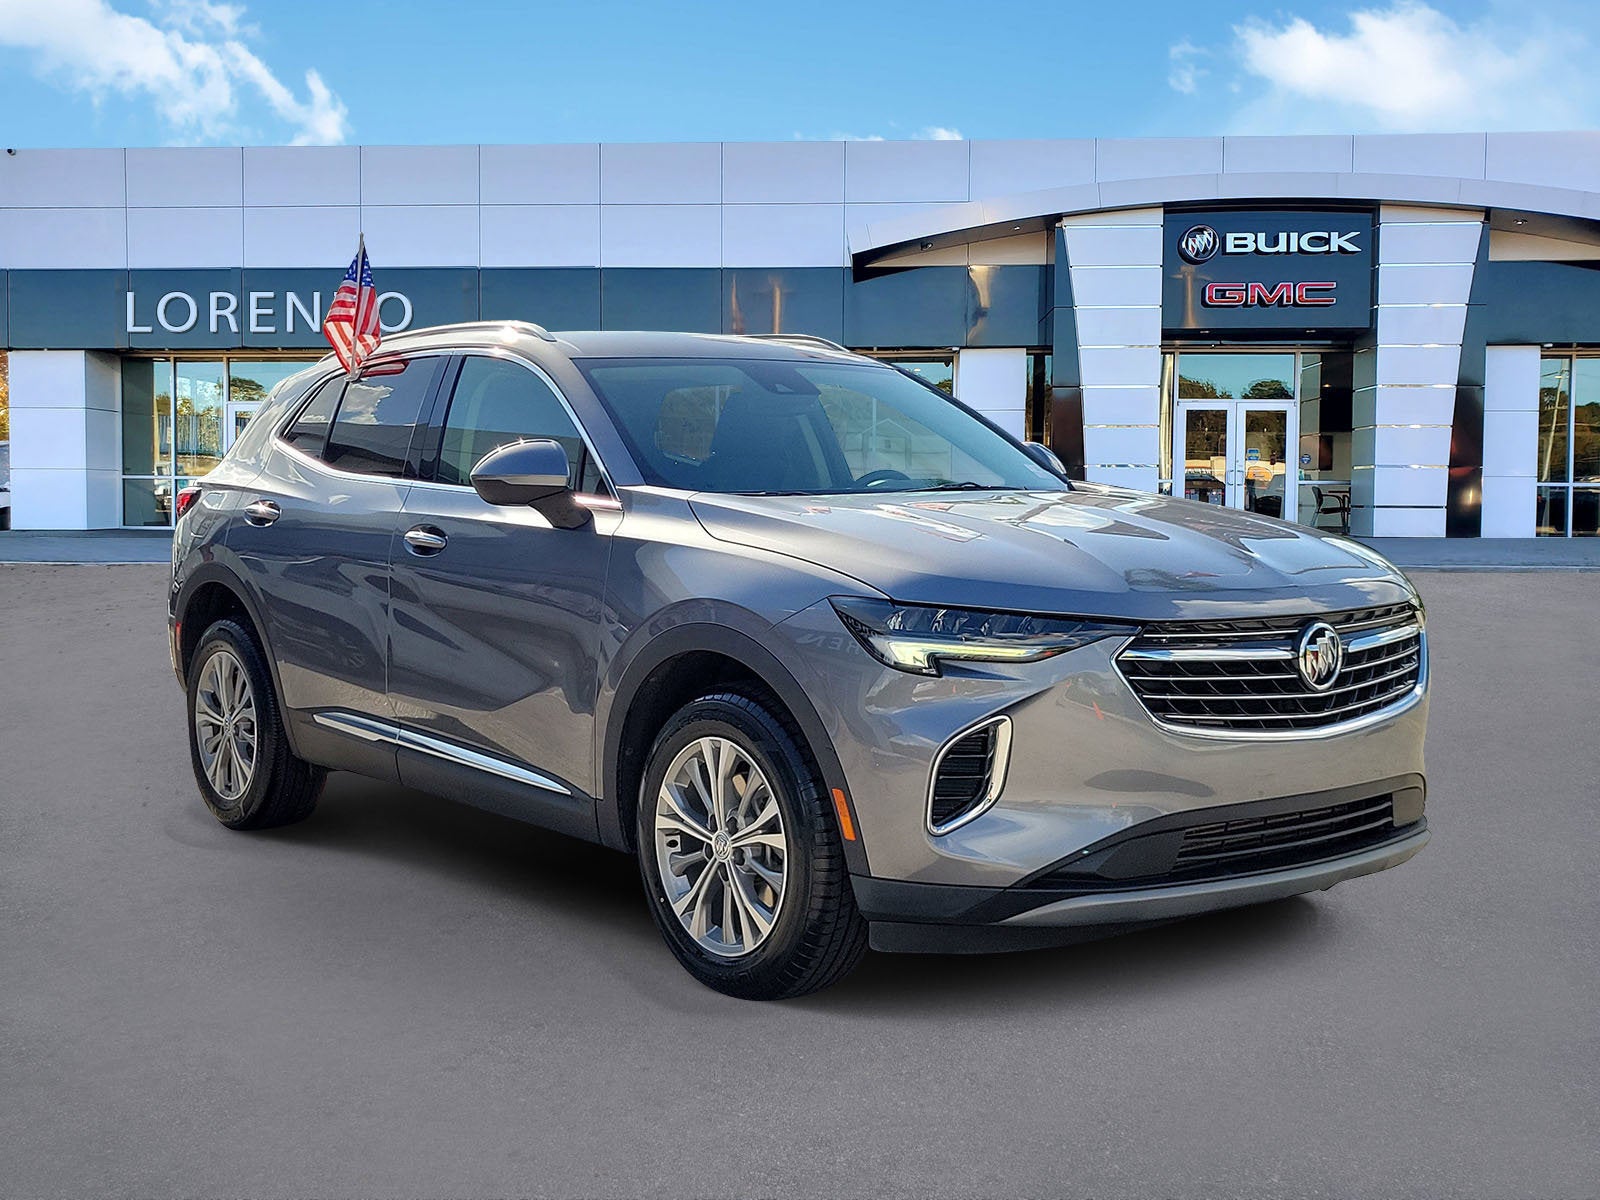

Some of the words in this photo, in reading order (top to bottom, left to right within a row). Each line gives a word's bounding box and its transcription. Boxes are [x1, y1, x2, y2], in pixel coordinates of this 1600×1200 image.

[1225, 231, 1362, 253] BUICK
[1205, 281, 1337, 305] GMC
[126, 290, 413, 334] LORENO
